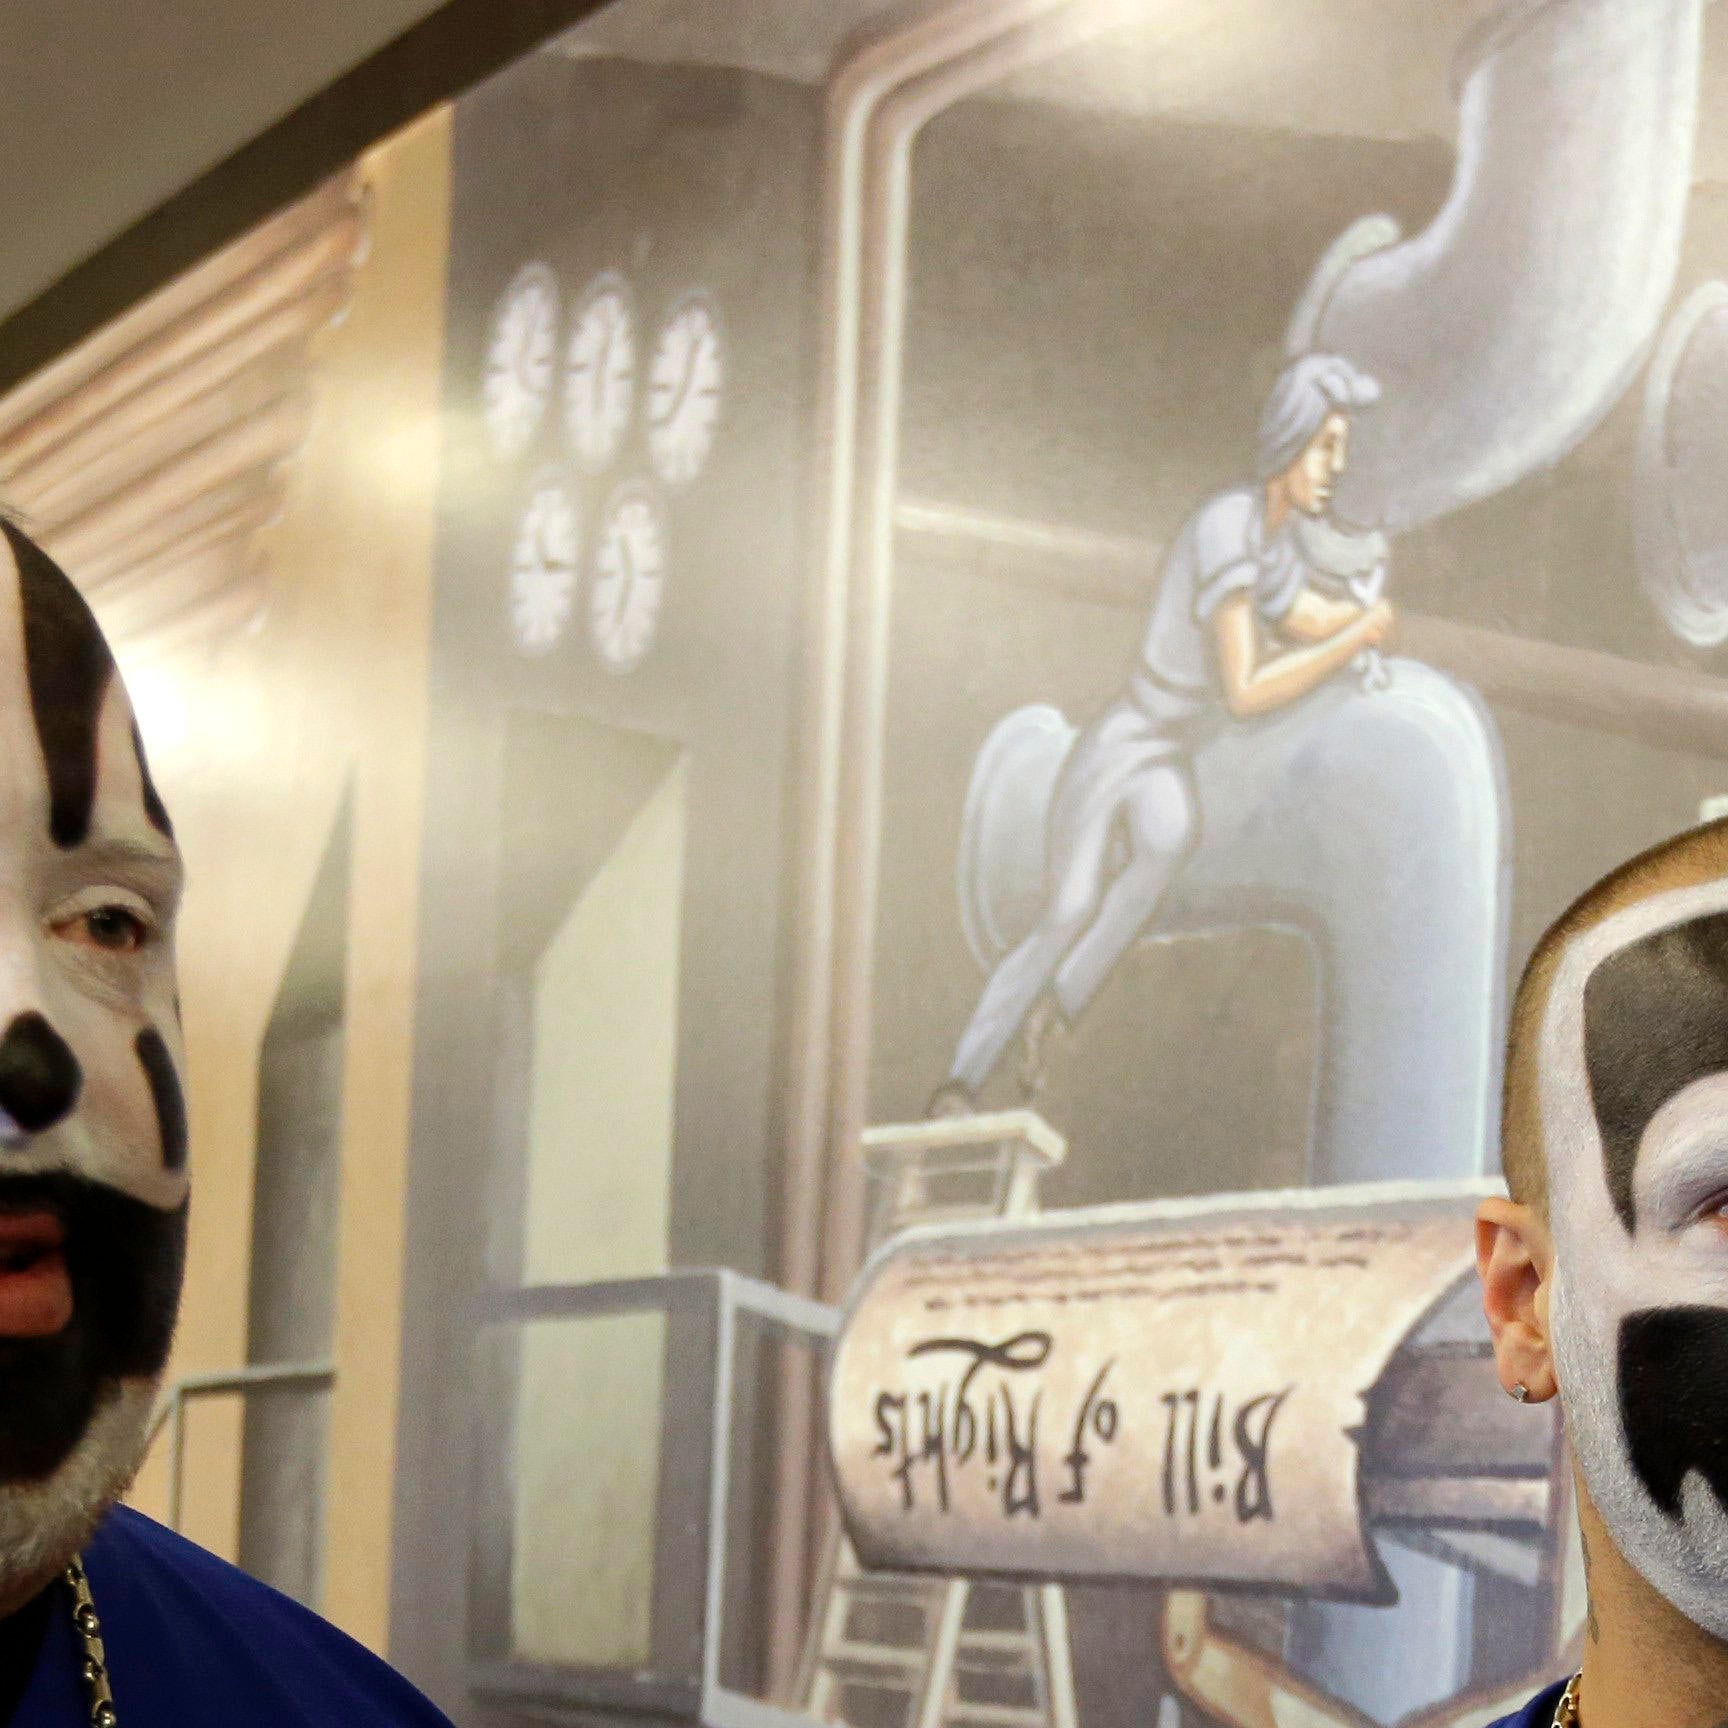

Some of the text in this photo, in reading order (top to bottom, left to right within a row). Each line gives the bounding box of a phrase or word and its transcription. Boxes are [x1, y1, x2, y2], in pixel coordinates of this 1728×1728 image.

[872, 1331, 1290, 1523] Bill of Rights
